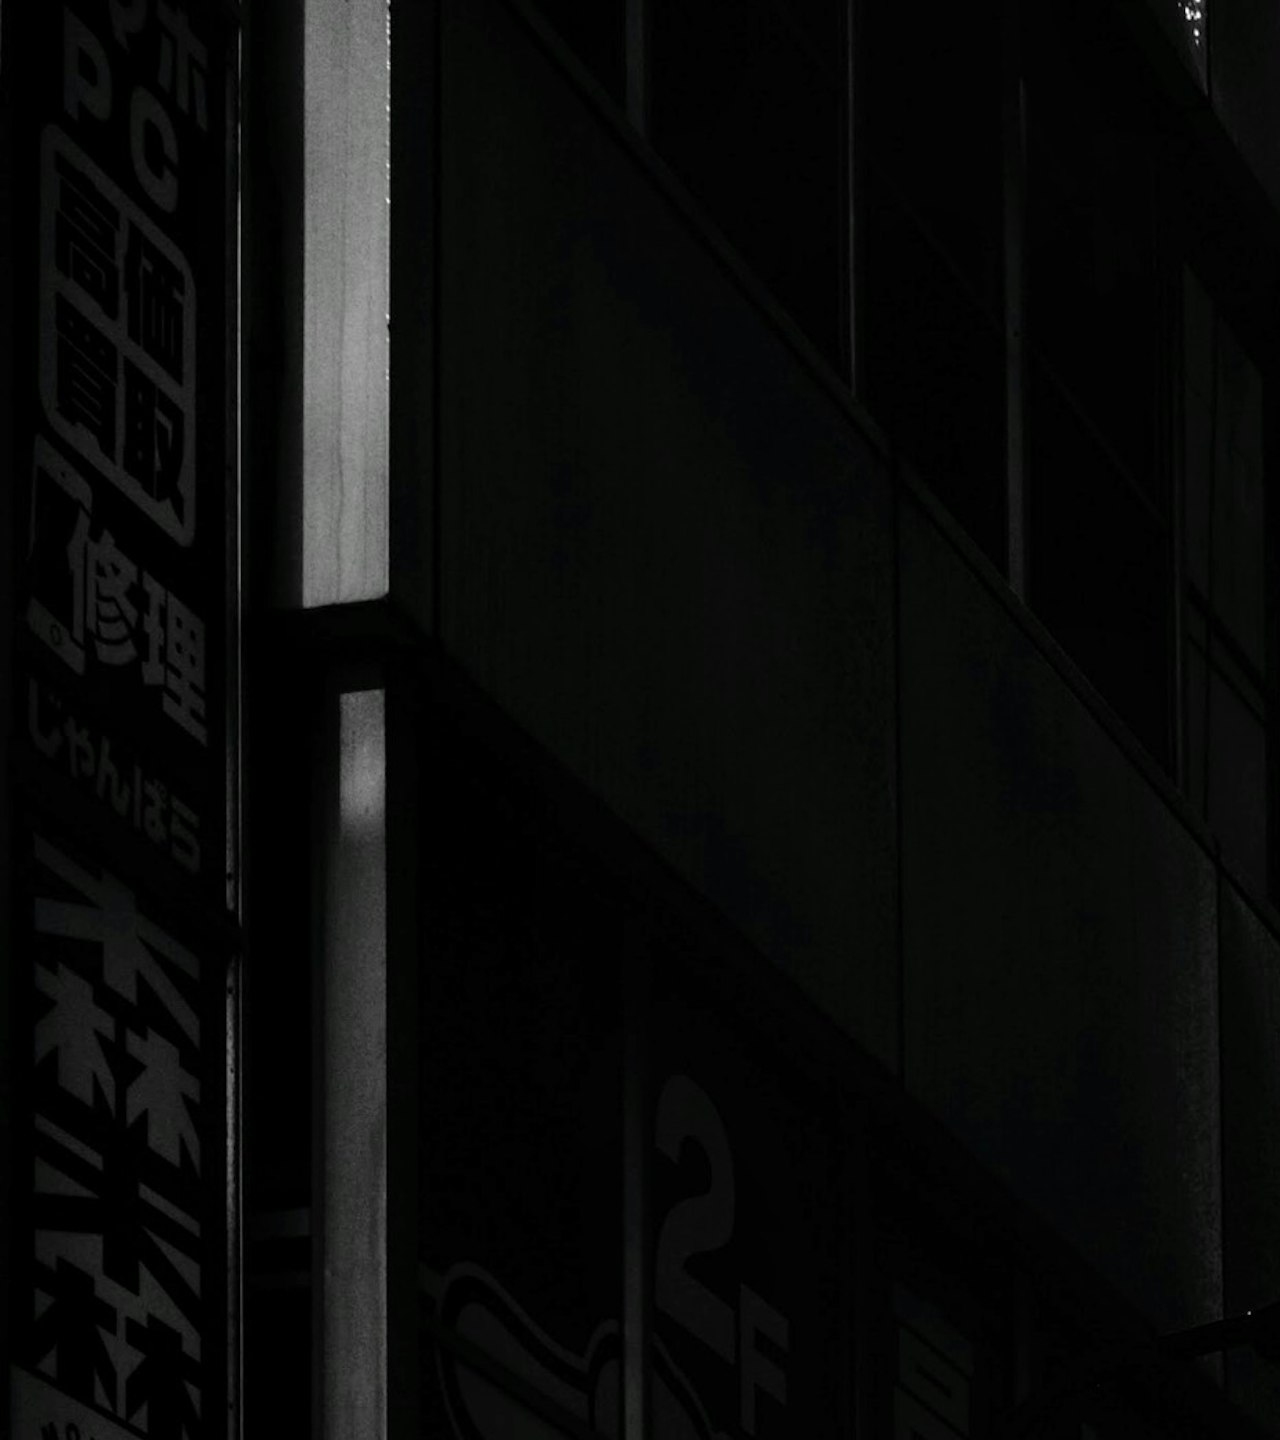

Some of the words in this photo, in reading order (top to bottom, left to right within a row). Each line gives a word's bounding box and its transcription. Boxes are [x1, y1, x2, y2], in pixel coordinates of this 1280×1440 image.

[61, 2, 180, 215] PC
[68, 525, 209, 748] 修理
[654, 1072, 792, 1438] 2F
